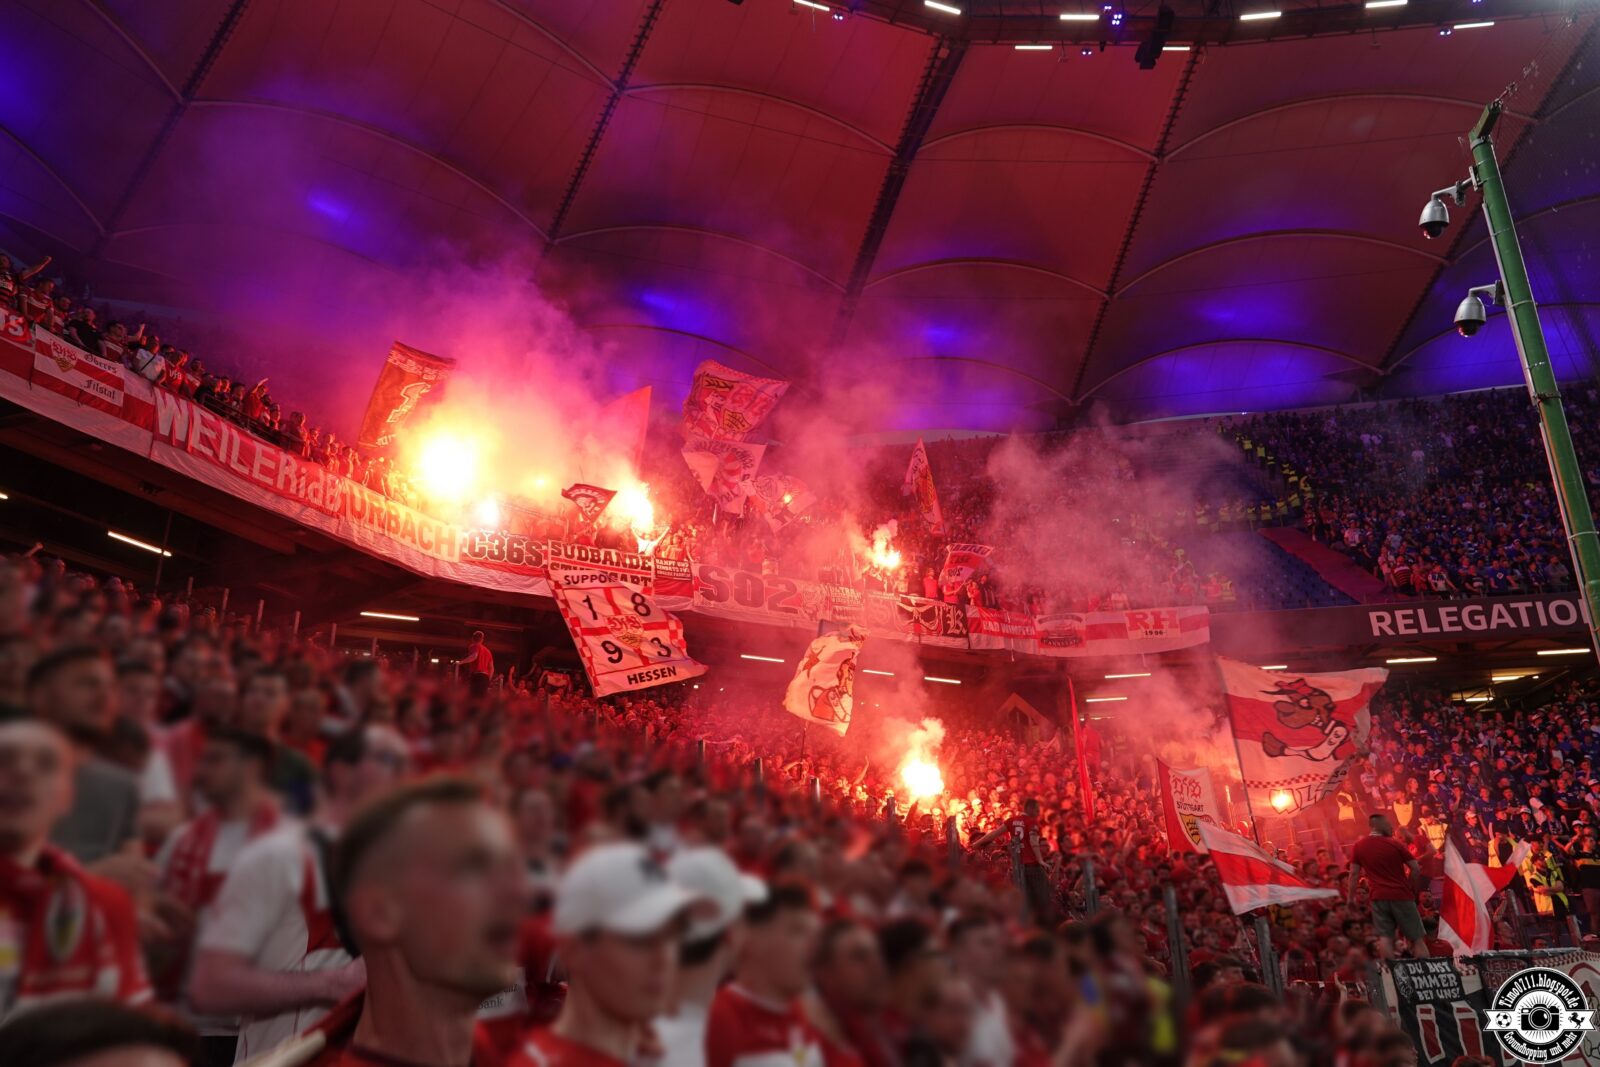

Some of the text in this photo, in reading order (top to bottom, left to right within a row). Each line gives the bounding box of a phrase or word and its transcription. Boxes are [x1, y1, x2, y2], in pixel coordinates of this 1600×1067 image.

[84, 354, 117, 374] Oberes
[83, 379, 116, 401] Filstal
[583, 593, 651, 620] 1 8
[1125, 610, 1178, 631] RH
[601, 637, 672, 664] 9 3
[627, 666, 677, 685] HESSEN
[1176, 801, 1204, 812] STUTTGART
[1426, 961, 1451, 974] BIST
[1411, 973, 1458, 989] IMMER
[1417, 987, 1461, 1000] BEI UNS!
